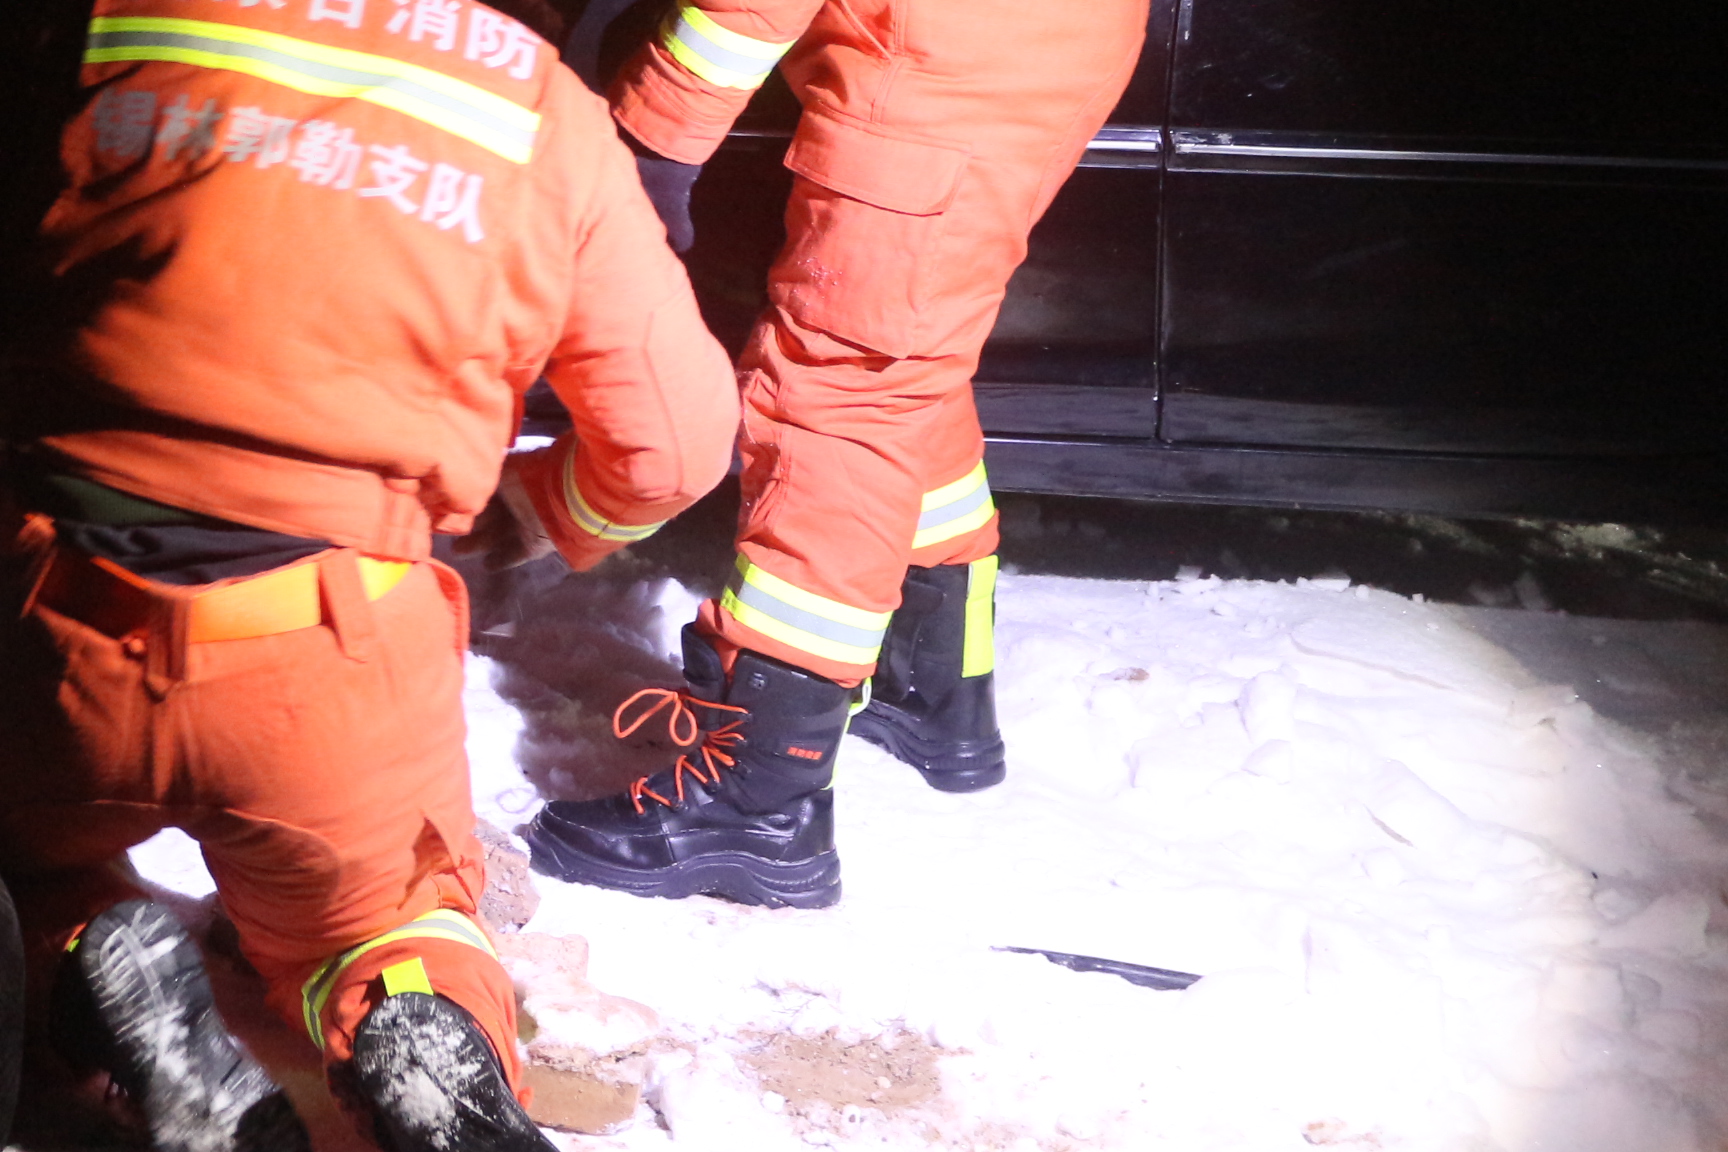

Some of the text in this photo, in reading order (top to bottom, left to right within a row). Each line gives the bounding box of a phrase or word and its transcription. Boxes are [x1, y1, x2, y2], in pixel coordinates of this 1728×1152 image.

[89, 87, 485, 242] 锡林郭勒支队
